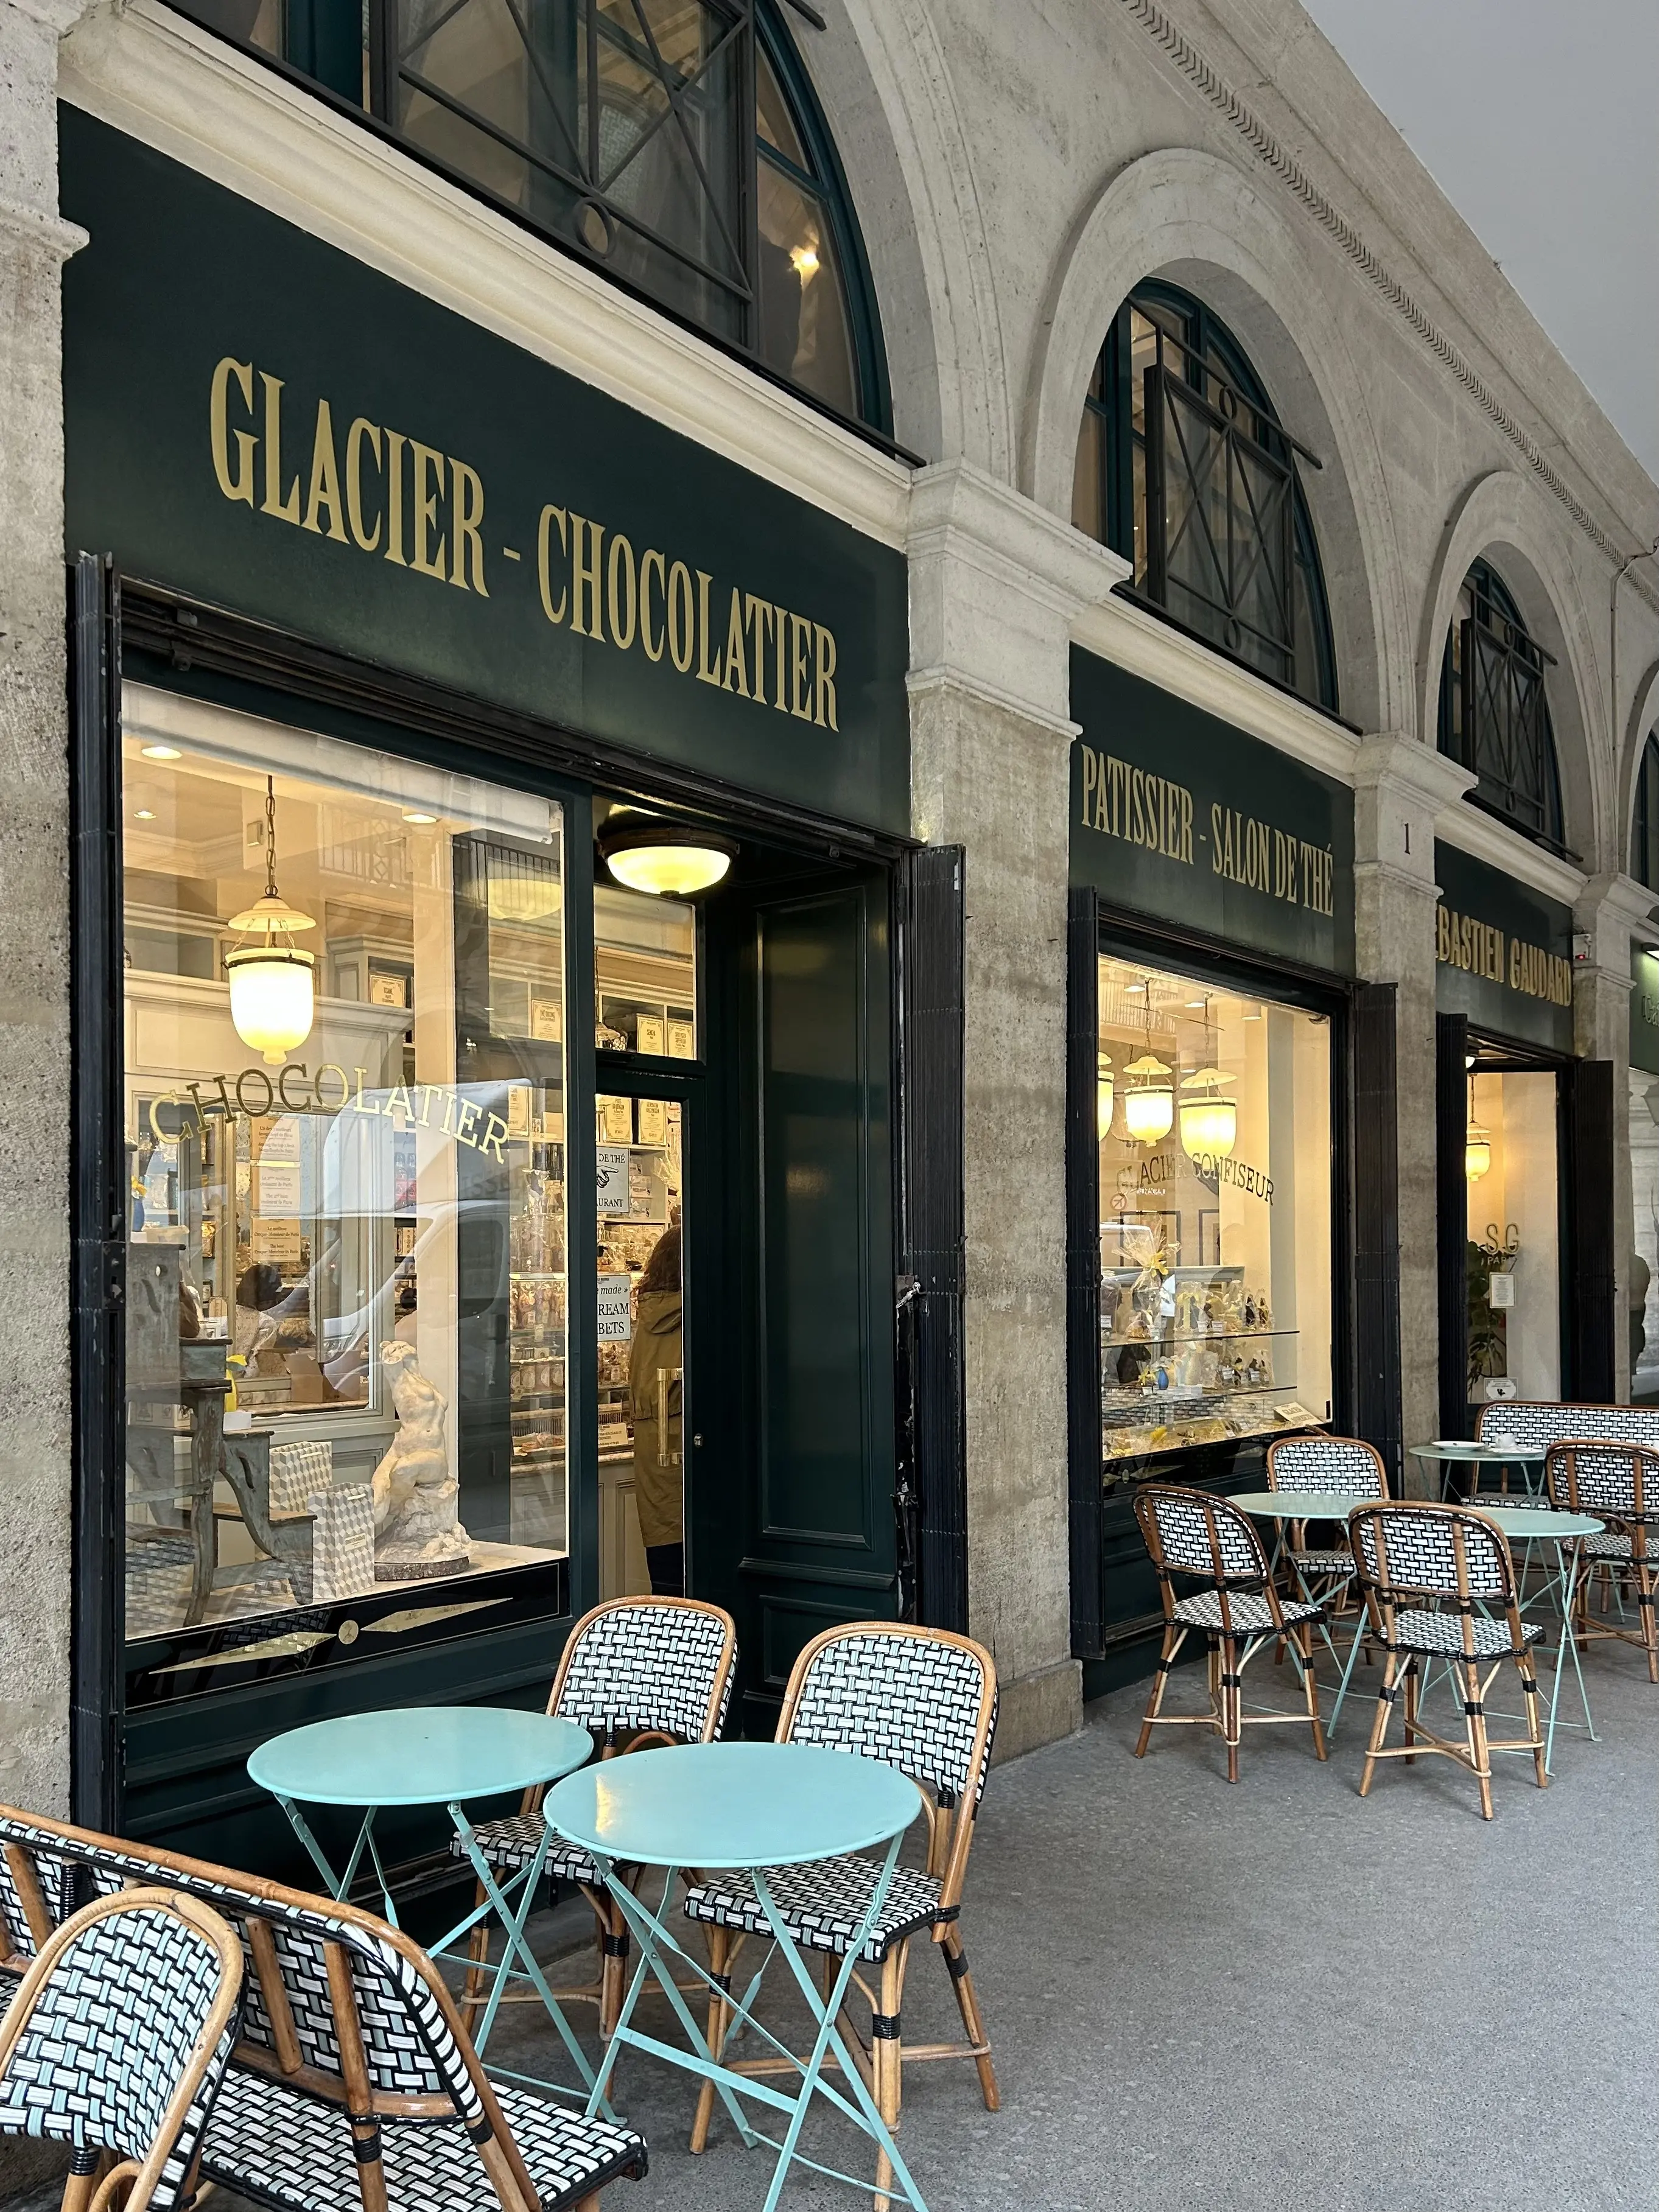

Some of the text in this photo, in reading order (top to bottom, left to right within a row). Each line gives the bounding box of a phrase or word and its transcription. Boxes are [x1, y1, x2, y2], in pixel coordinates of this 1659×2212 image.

[210, 357, 489, 597] GLACIER
[538, 504, 839, 732] CHOCOLATIER
[1081, 744, 1194, 865] PATISSIER
[1212, 802, 1271, 894] SALON
[1274, 829, 1297, 903] DE
[1300, 841, 1333, 917] THÉ
[1435, 905, 1572, 1007] BASTIEN GAUDARD
[149, 1063, 510, 1164] CHOCOLATIER
[598, 1153, 625, 1163] DE THÉ
[1116, 1152, 1274, 1206] GLACIER CONFISEUR
[597, 1198, 623, 1207] URANT
[600, 1284, 622, 1294] made
[598, 1303, 629, 1315] REAM
[598, 1321, 625, 1334] BETS
